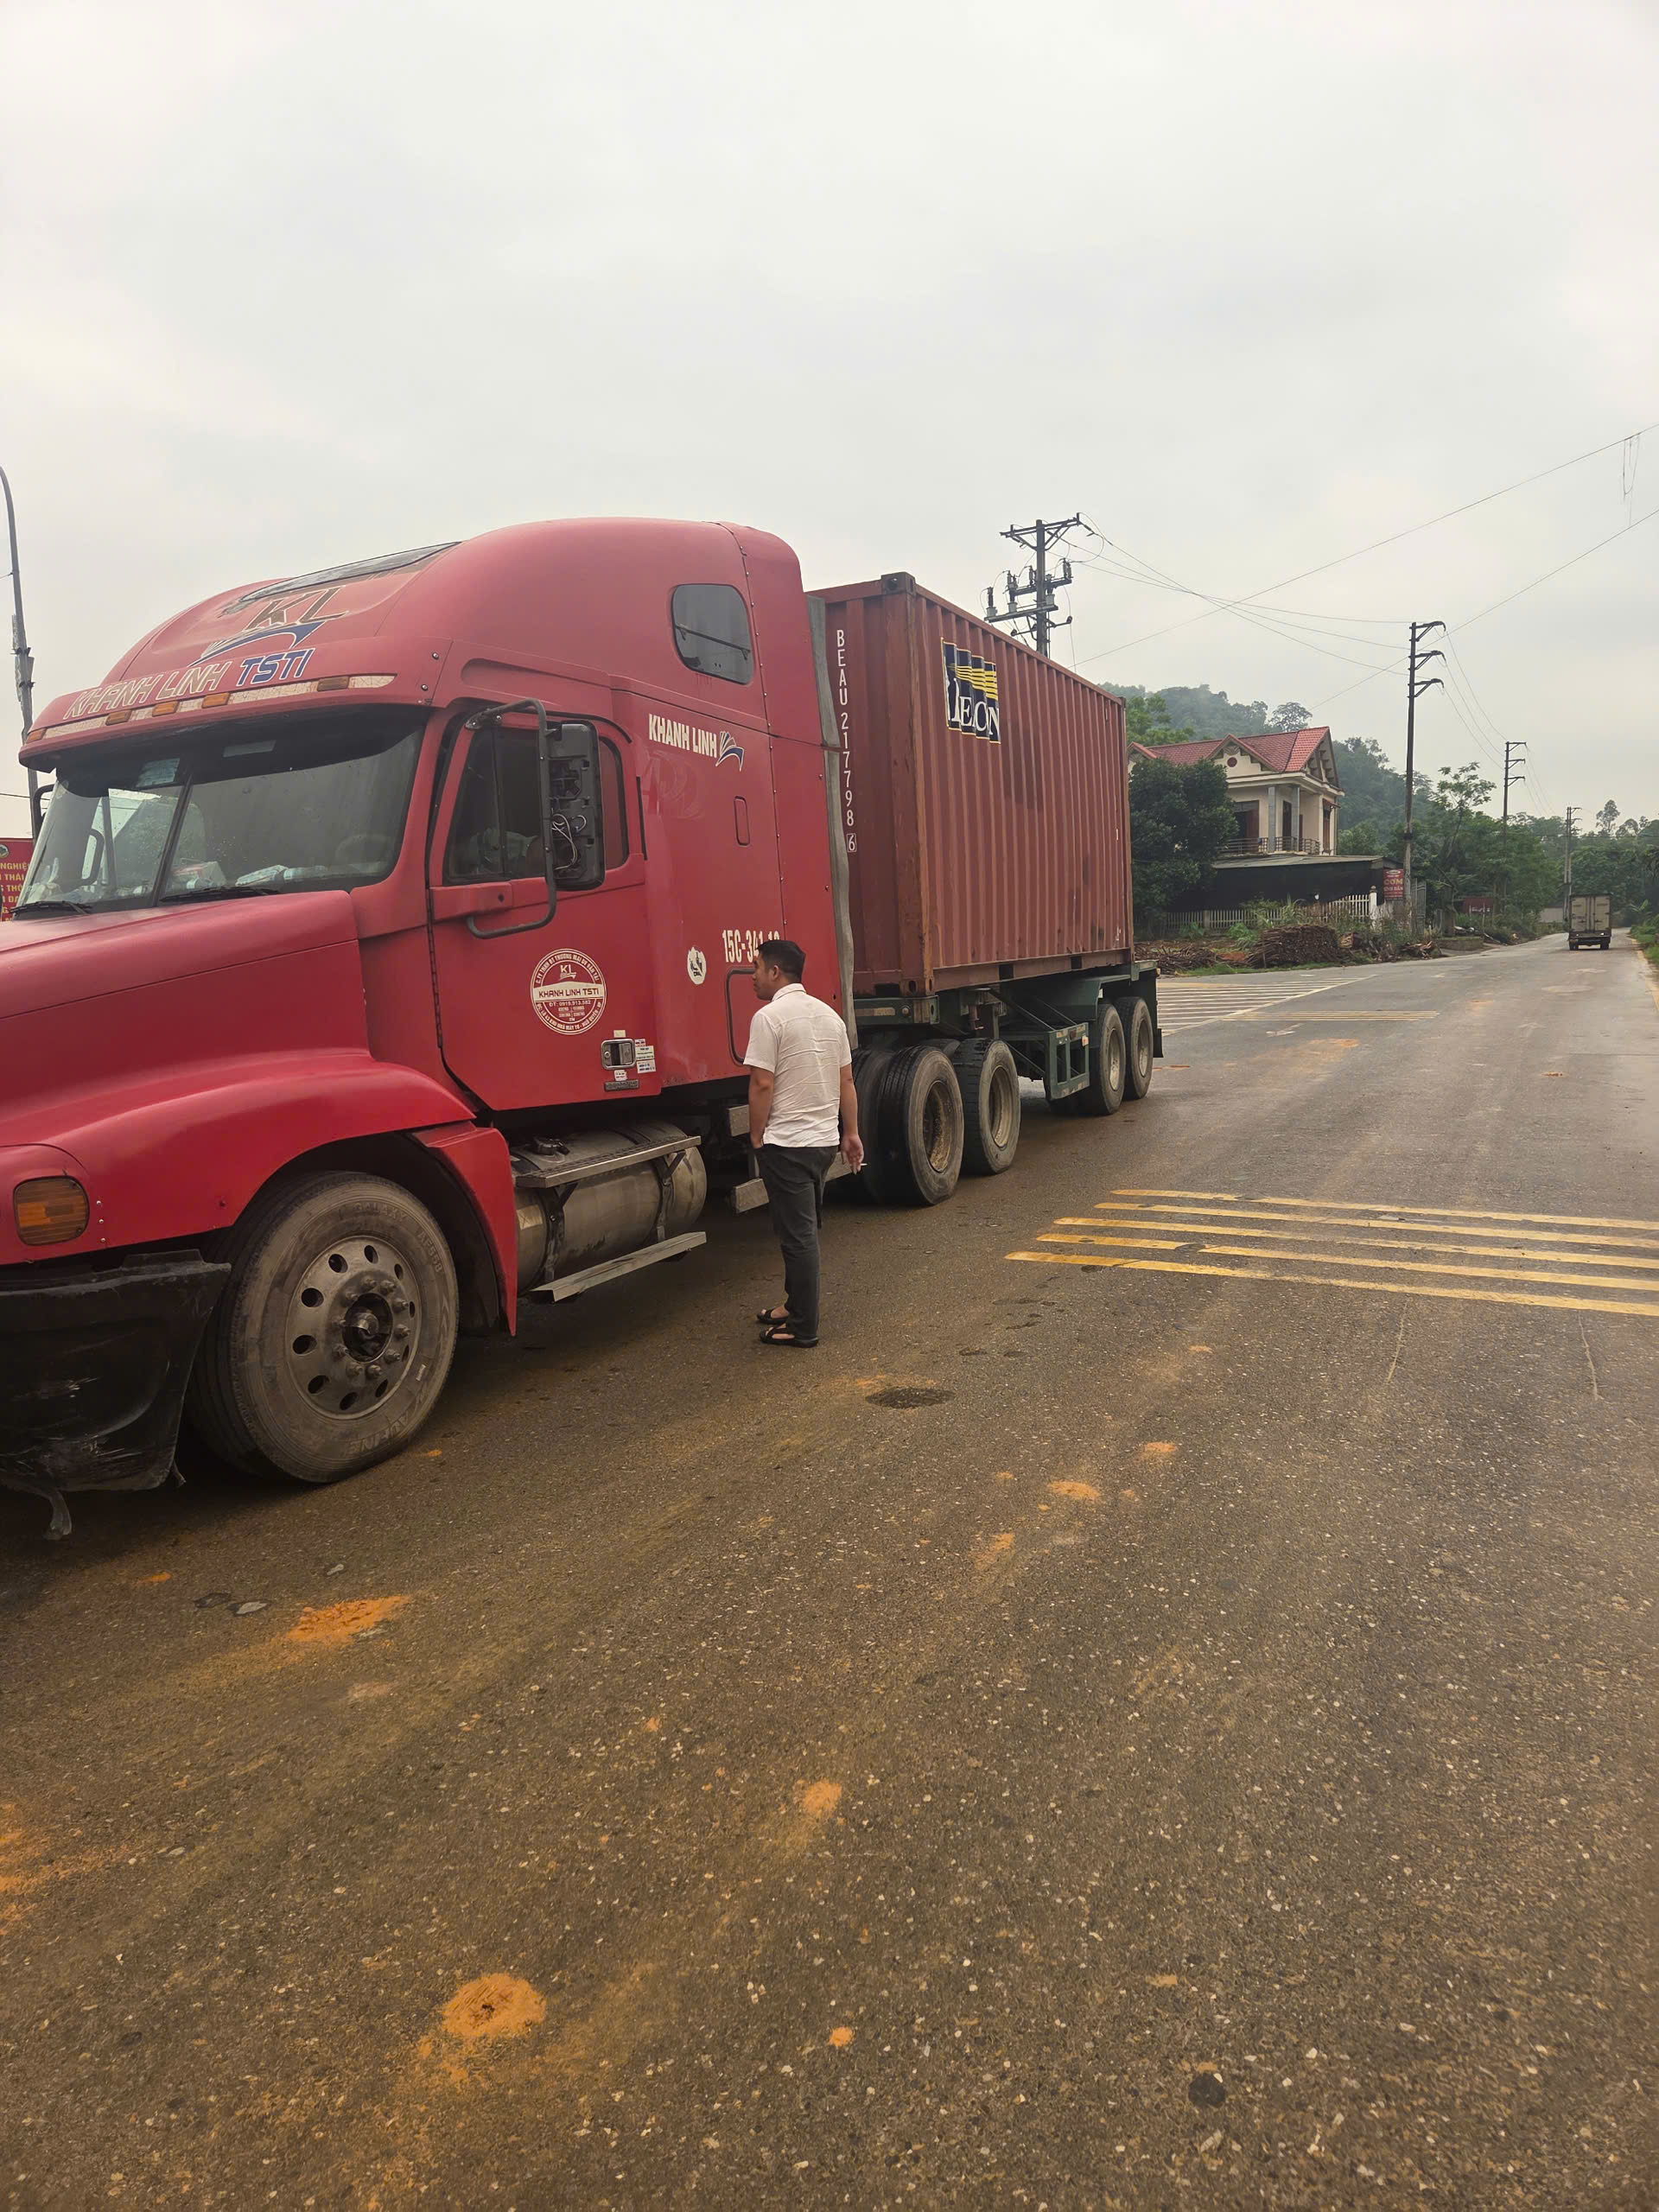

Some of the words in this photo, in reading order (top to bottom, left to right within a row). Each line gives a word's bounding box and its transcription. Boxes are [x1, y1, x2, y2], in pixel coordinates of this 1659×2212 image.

[62, 674, 163, 719] KHANH
[156, 662, 232, 701] LINH
[236, 648, 315, 686] TSTI
[836, 629, 848, 706] BEAU
[649, 713, 690, 751] KHANH
[692, 727, 717, 759] LINH
[841, 712, 855, 827] 217798
[0, 861, 29, 872] NGHIỆ
[538, 989, 563, 998] KHANH
